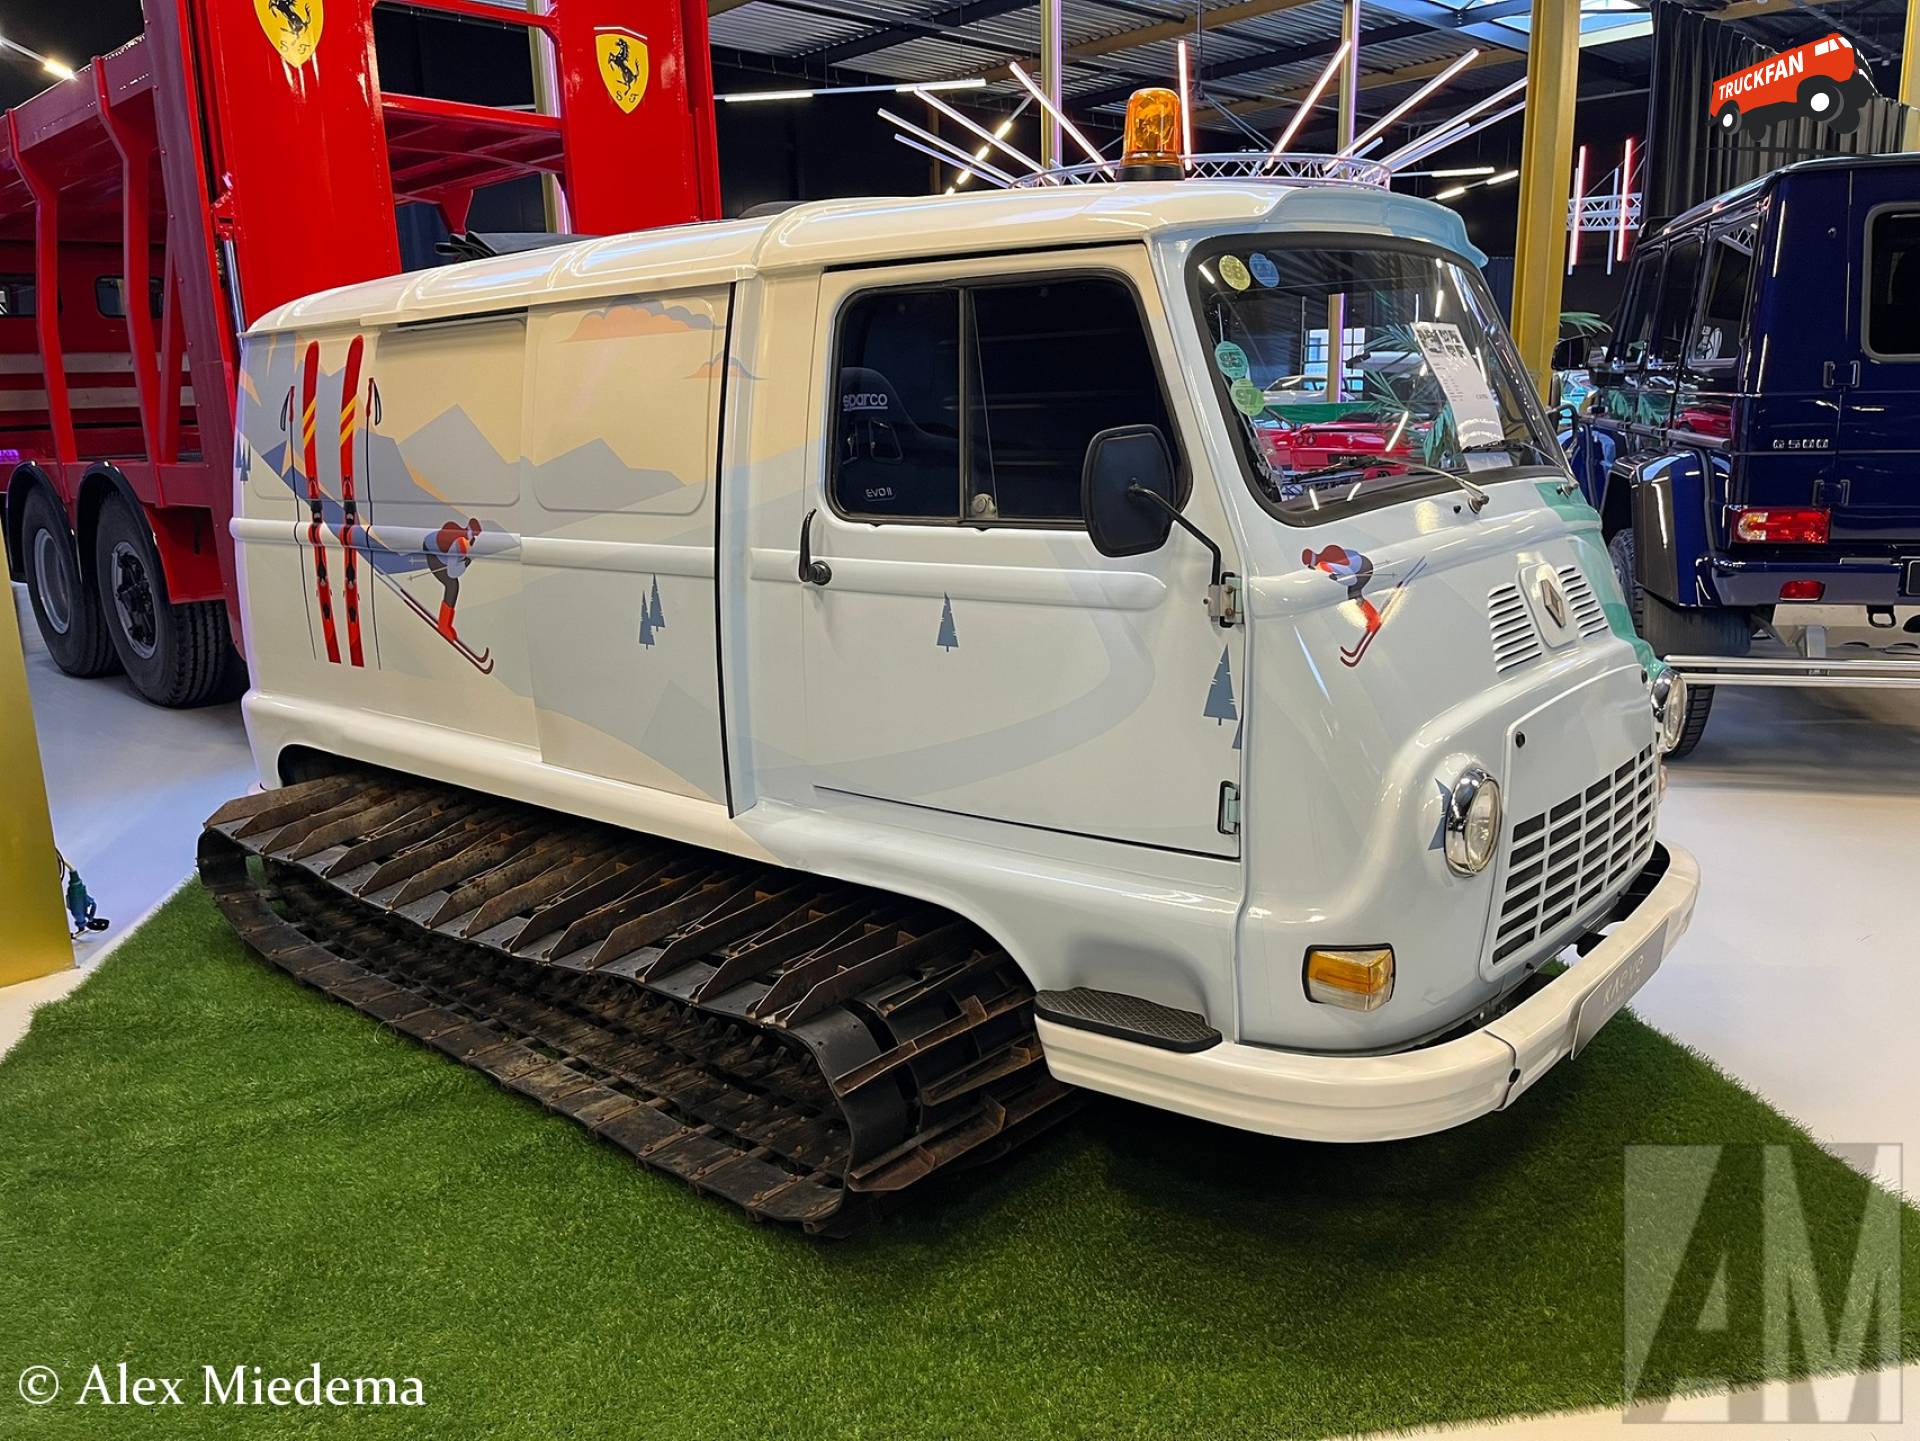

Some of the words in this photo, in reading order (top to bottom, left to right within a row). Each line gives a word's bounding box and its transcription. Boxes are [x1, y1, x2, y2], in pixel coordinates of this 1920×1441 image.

[1219, 351, 1245, 368] 95
[842, 393, 889, 409] sparco
[1235, 389, 1259, 406] 97
